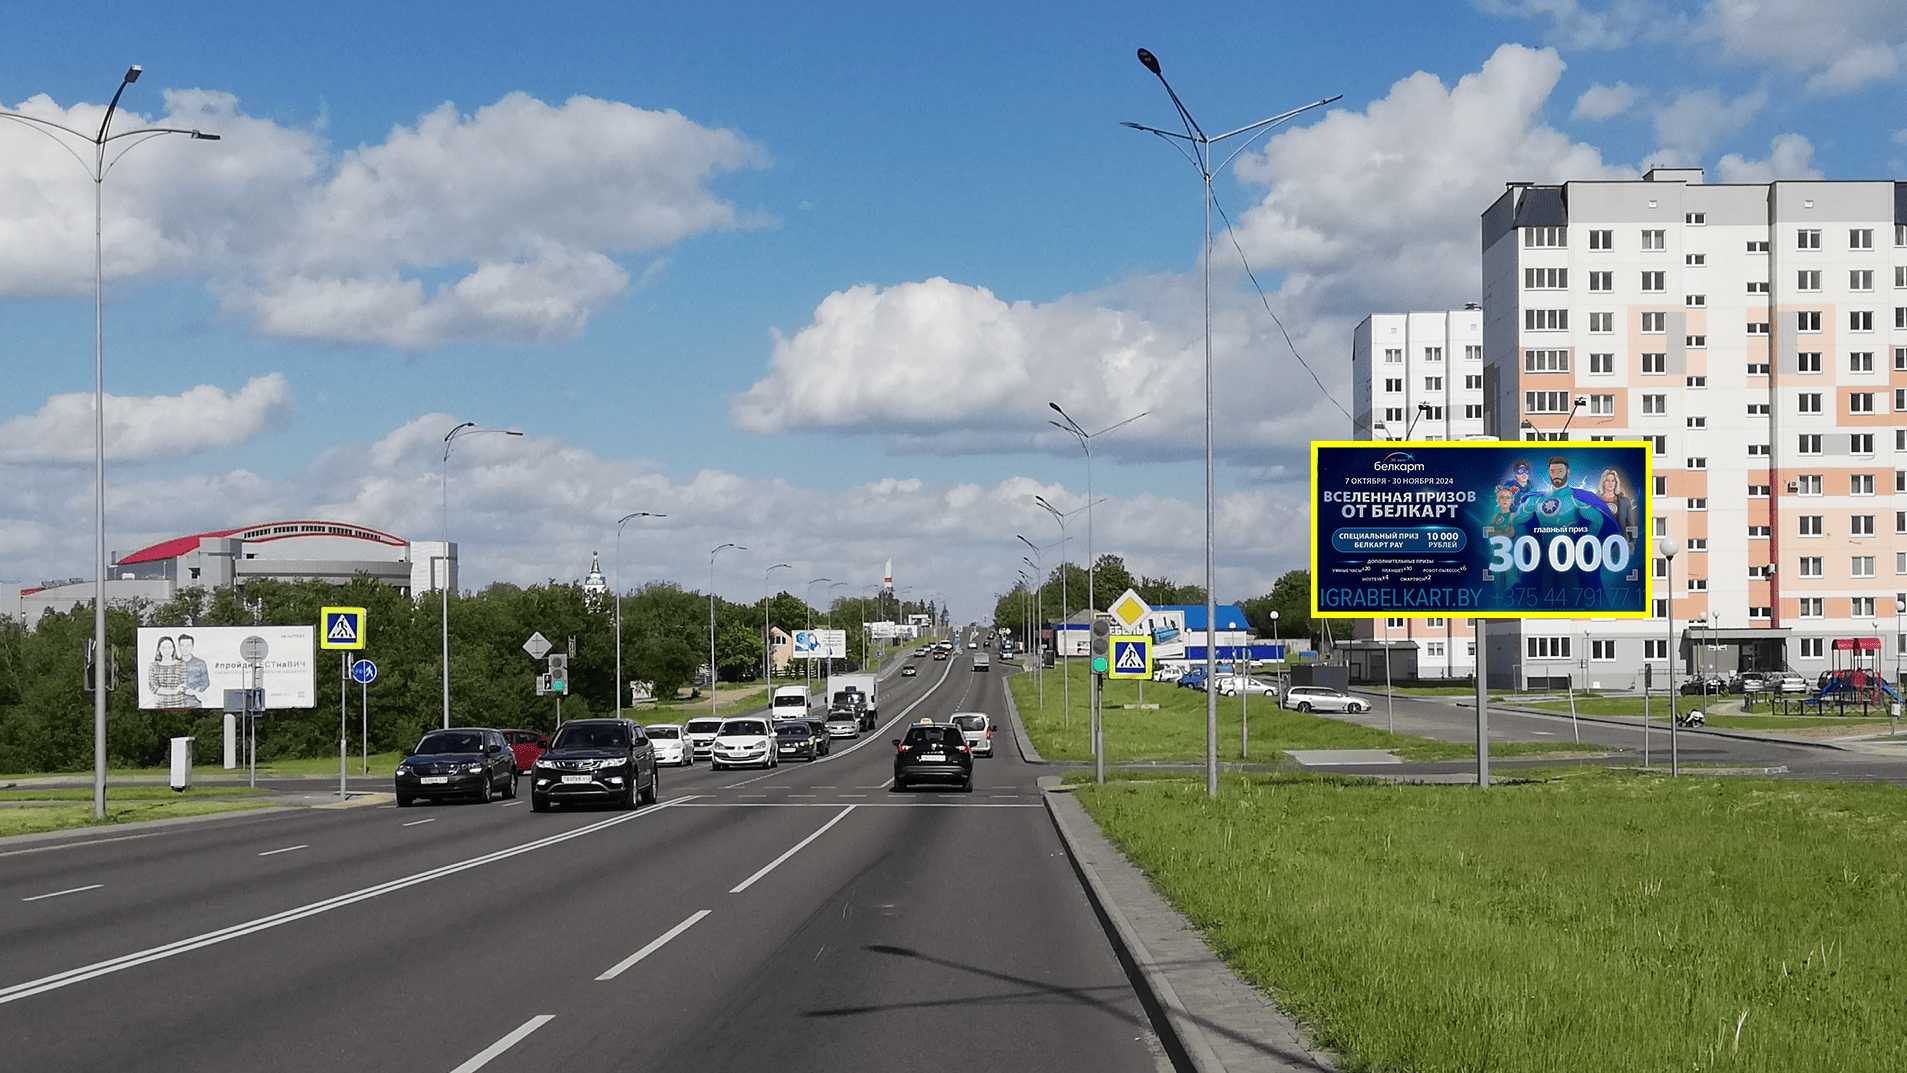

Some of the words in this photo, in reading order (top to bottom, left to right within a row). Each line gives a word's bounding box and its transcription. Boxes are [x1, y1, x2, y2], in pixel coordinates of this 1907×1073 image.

[1373, 461, 1425, 474] белкарт
[1345, 477, 1350, 485] 7
[1351, 477, 1387, 485] ОКТЯБРЯ
[1392, 477, 1402, 485] 30
[1403, 477, 1434, 485] НОЯБРЯ
[1435, 477, 1454, 485] 2024
[1323, 490, 1413, 503] ВСЕЛЕННАЯ
[1415, 490, 1477, 503] ПРИЗОВ
[1341, 504, 1367, 519] ОТ
[1371, 504, 1459, 519] БЕЛКАРТ
[1533, 525, 1568, 534] главный
[1568, 527, 1589, 535] приз
[1338, 531, 1398, 541] СПЕЦИАЛЬНЫЙ
[1426, 532, 1439, 541] 10
[1440, 532, 1459, 541] 000
[1354, 541, 1389, 549] БЕЛКАРТ
[1389, 541, 1404, 549] PAY
[1428, 541, 1458, 549] РУБЛЕЙ
[1488, 534, 1541, 573] 30
[1548, 534, 1630, 573] 000
[1320, 587, 1484, 607] IGRABELKART.BY
[1491, 587, 1538, 607] +375
[1543, 587, 1568, 607] 44
[1572, 587, 1603, 607] 791
[1608, 587, 1631, 607] 77
